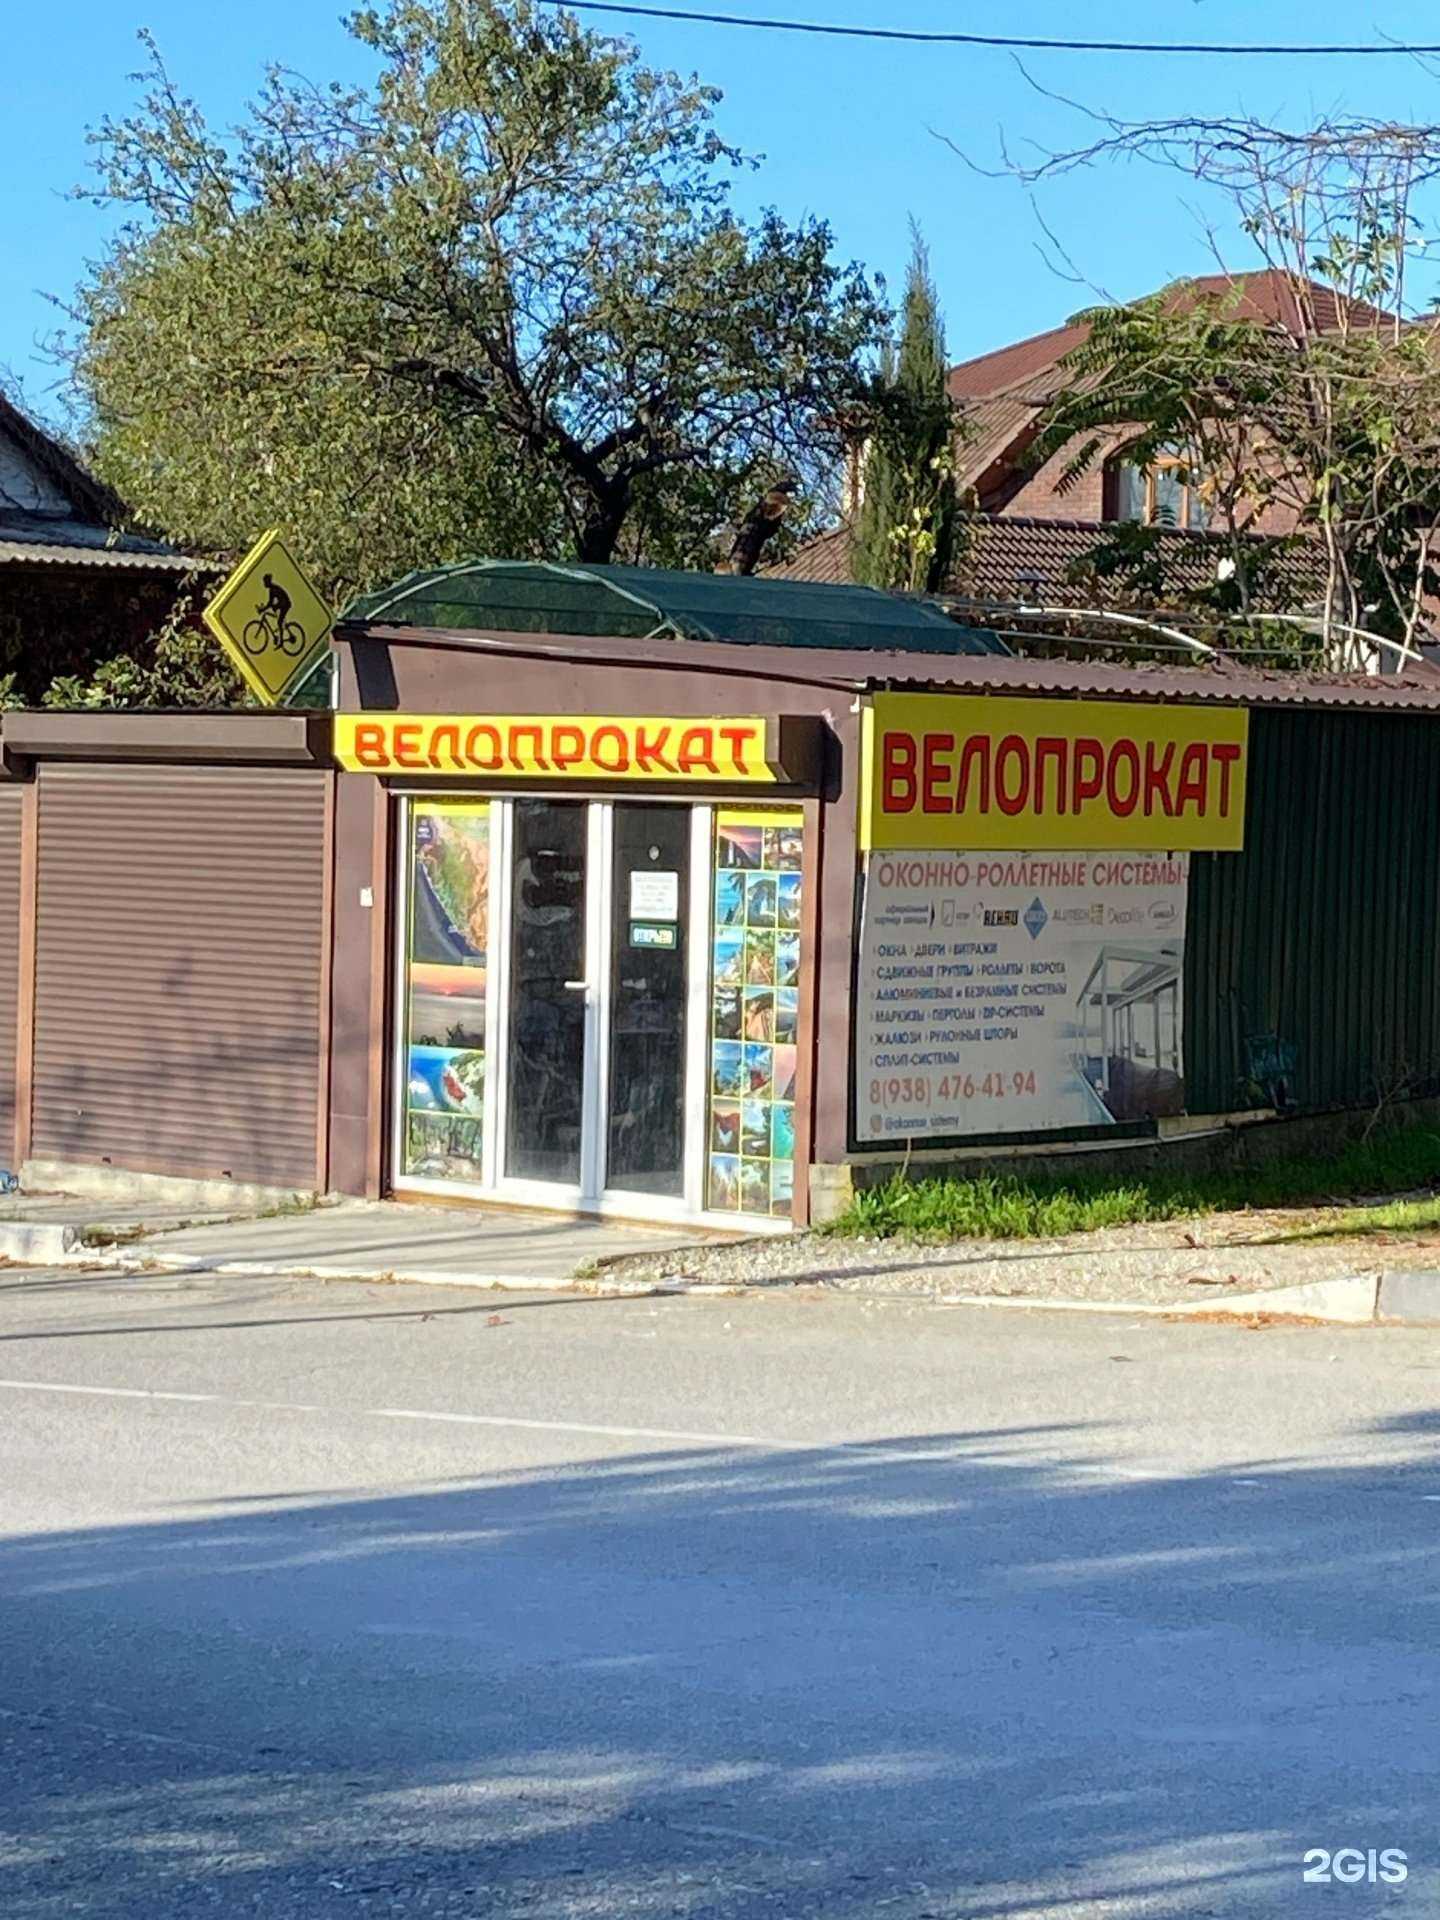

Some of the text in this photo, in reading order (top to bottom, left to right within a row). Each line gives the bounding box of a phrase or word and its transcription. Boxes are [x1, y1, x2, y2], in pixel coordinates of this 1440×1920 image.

[354, 724, 756, 774] ВЕЛОПРОКАТ
[882, 732, 1242, 817] ВЕЛОПРОКАТ
[1092, 860, 1182, 886] СИСТЕМЫ
[878, 942, 997, 958] ОКНА ДВЕРИ ВИТРАЖИ
[937, 963, 974, 978] ГРУППЫ
[1030, 960, 1066, 976] ВОРОТА
[1021, 981, 1067, 997] СИСТЕМЫ
[875, 1008, 925, 1023] МАРКИЗЫ
[932, 1006, 975, 1021] ПЕРГОЛЫ
[875, 1026, 1018, 1046] ЖАЛЮЗИ РУЛОННЫЕ ШТОРЫ
[869, 1070, 1036, 1109] 8(938) 476-41-94
